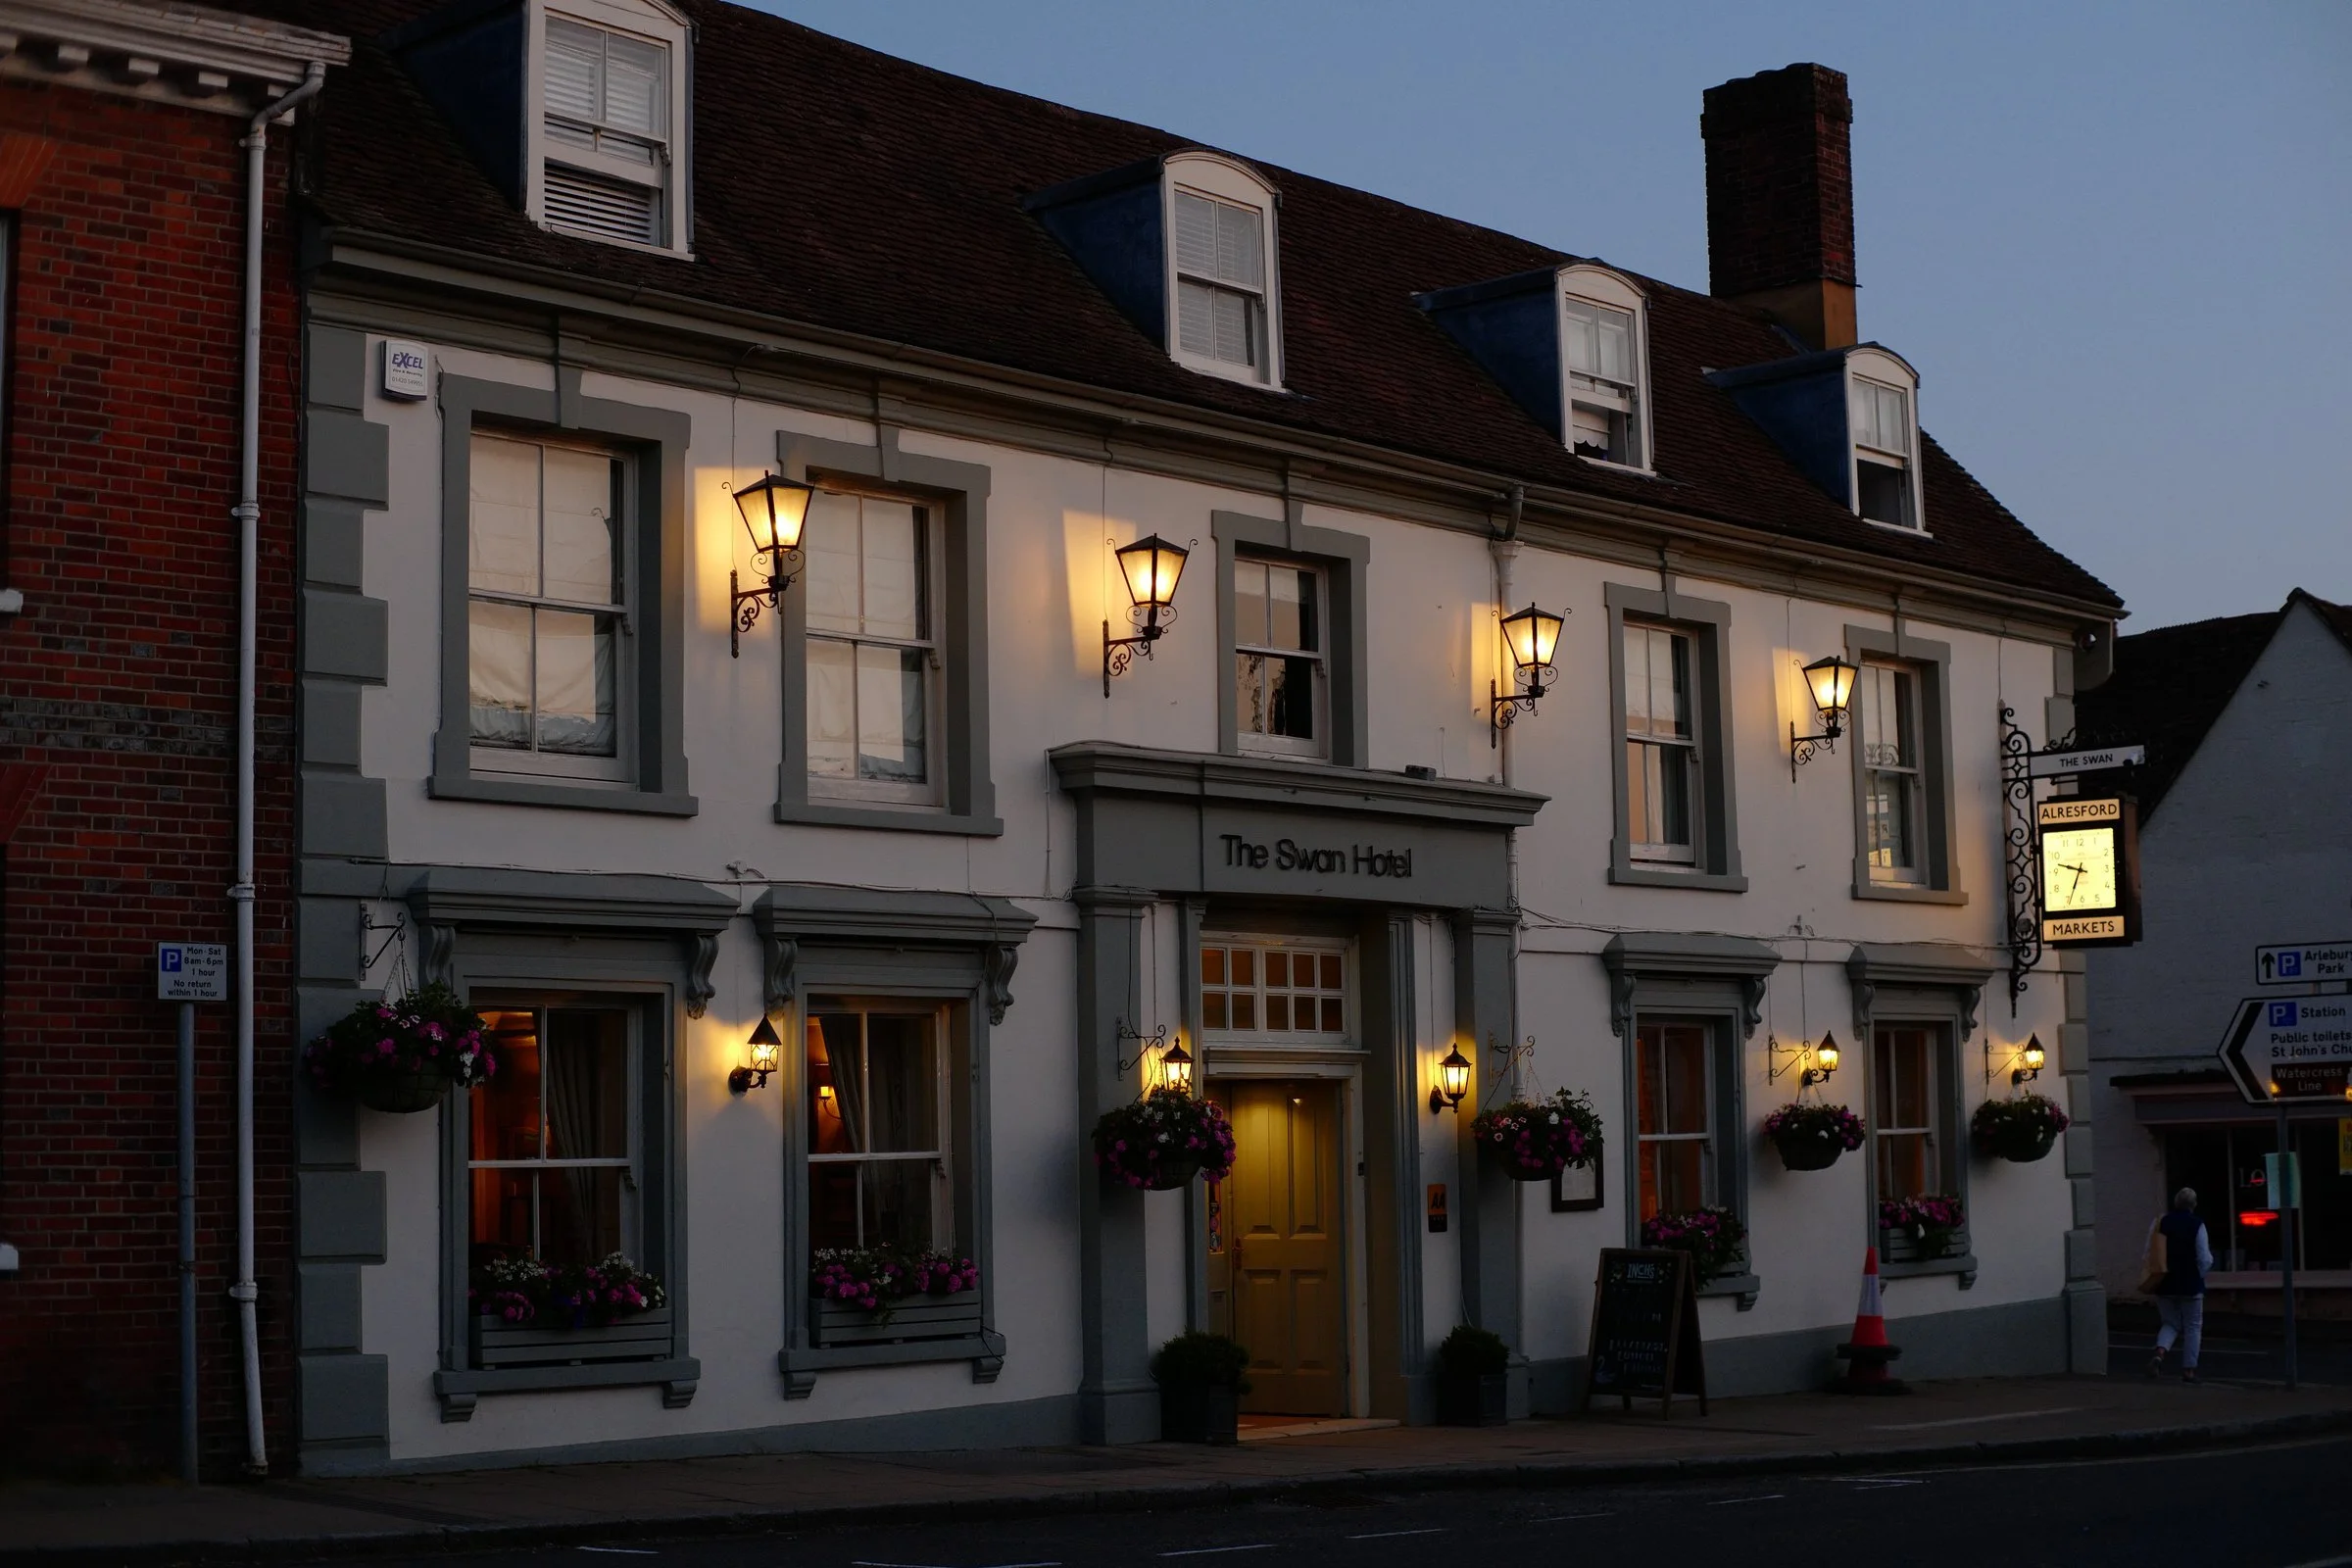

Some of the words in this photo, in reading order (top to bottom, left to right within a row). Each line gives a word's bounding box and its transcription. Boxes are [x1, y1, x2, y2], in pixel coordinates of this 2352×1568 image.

[392, 352, 423, 369] EXCEL
[2059, 758, 2079, 767] THE
[2082, 754, 2113, 765] SWAN
[2041, 804, 2117, 819] ALRESFORD
[2077, 838, 2084, 847] 12
[1219, 834, 1269, 868] The
[1276, 838, 1346, 873] Swan
[1352, 845, 1411, 878] Hotel
[2051, 852, 2060, 860] 10
[2104, 848, 2109, 857] 2
[2105, 864, 2109, 873] 3
[2054, 884, 2059, 893] 8
[2052, 921, 2115, 936] MARKETS
[167, 951, 179, 970] P
[2281, 955, 2295, 974] P
[2318, 962, 2345, 974] Park
[2273, 1005, 2286, 1024] P
[2301, 1005, 2346, 1018] Station
[2271, 1032, 2309, 1044] Public
[2313, 1030, 2352, 1042] toilets
[2272, 1046, 2285, 1057] St
[2290, 1045, 2328, 1056] John's
[2275, 1066, 2343, 1079] Watercress
[2298, 1079, 2323, 1092] Line
[1431, 1192, 1446, 1209] AA
